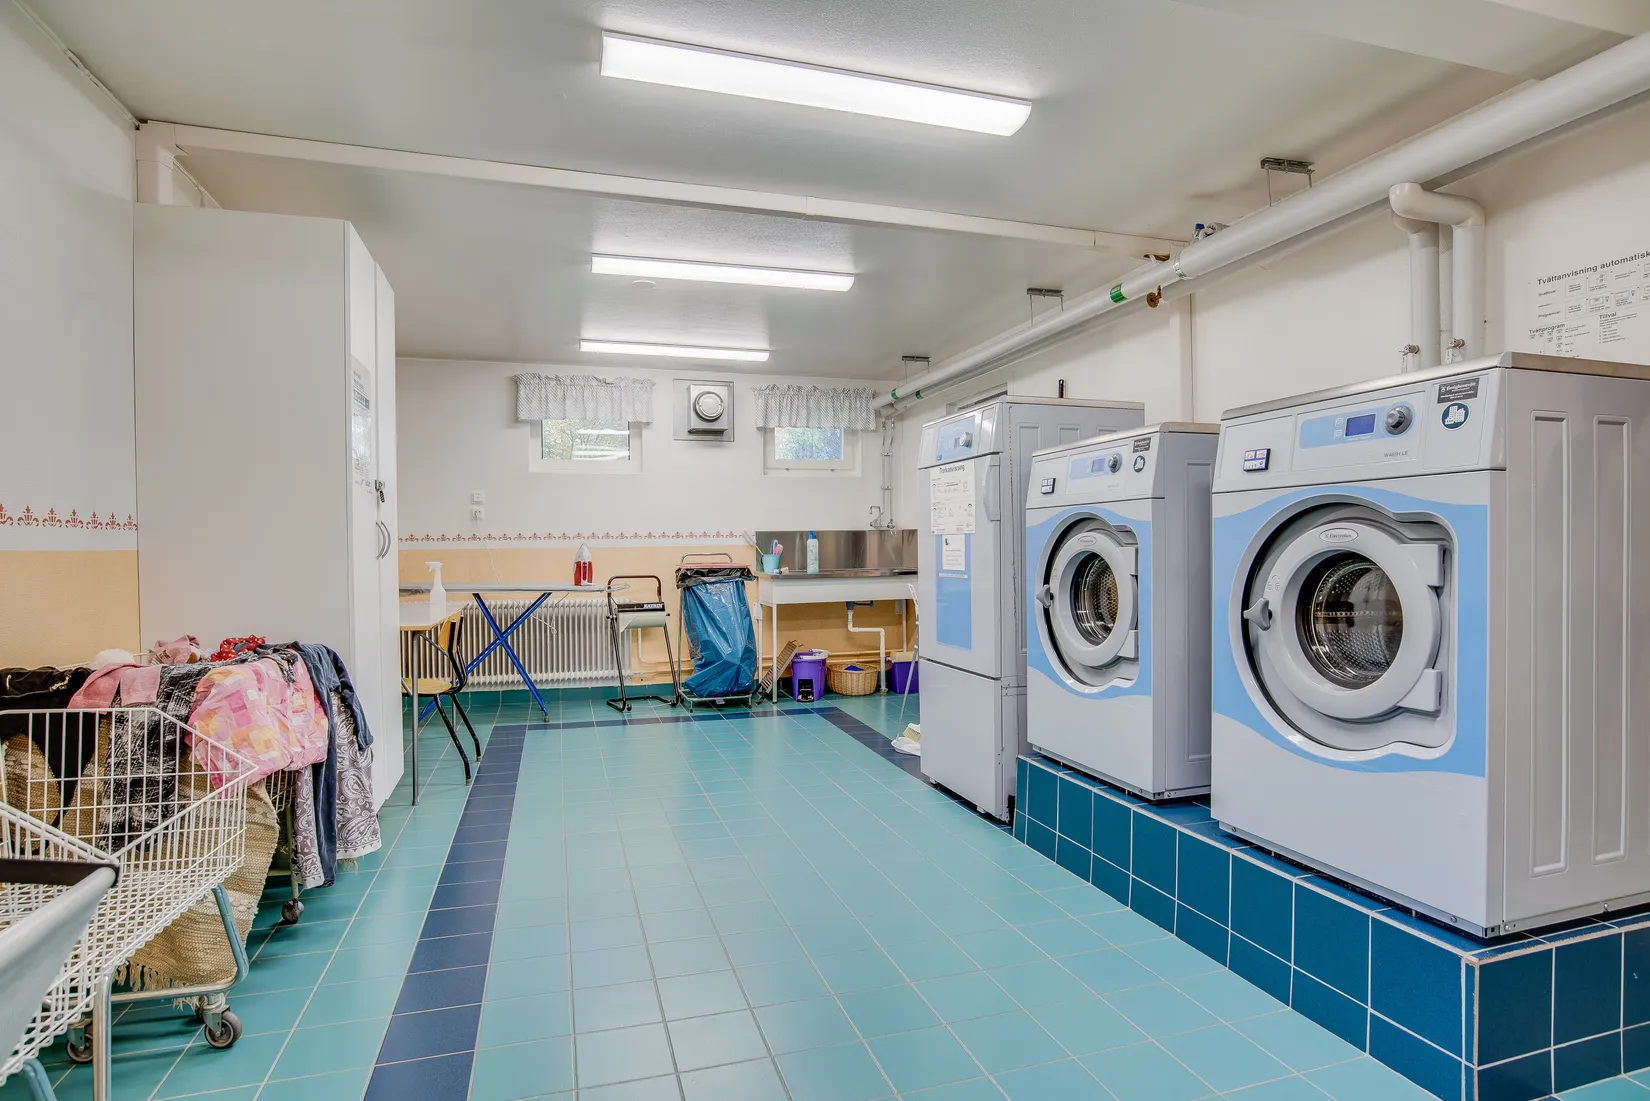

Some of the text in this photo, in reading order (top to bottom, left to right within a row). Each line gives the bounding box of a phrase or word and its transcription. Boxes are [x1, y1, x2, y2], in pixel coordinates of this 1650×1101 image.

[1537, 265, 1598, 285] Tvättanvisning
[1600, 251, 1650, 269] automatisk
[1599, 312, 1617, 320] Tillval
[1529, 323, 1566, 335] Tvättprogram
